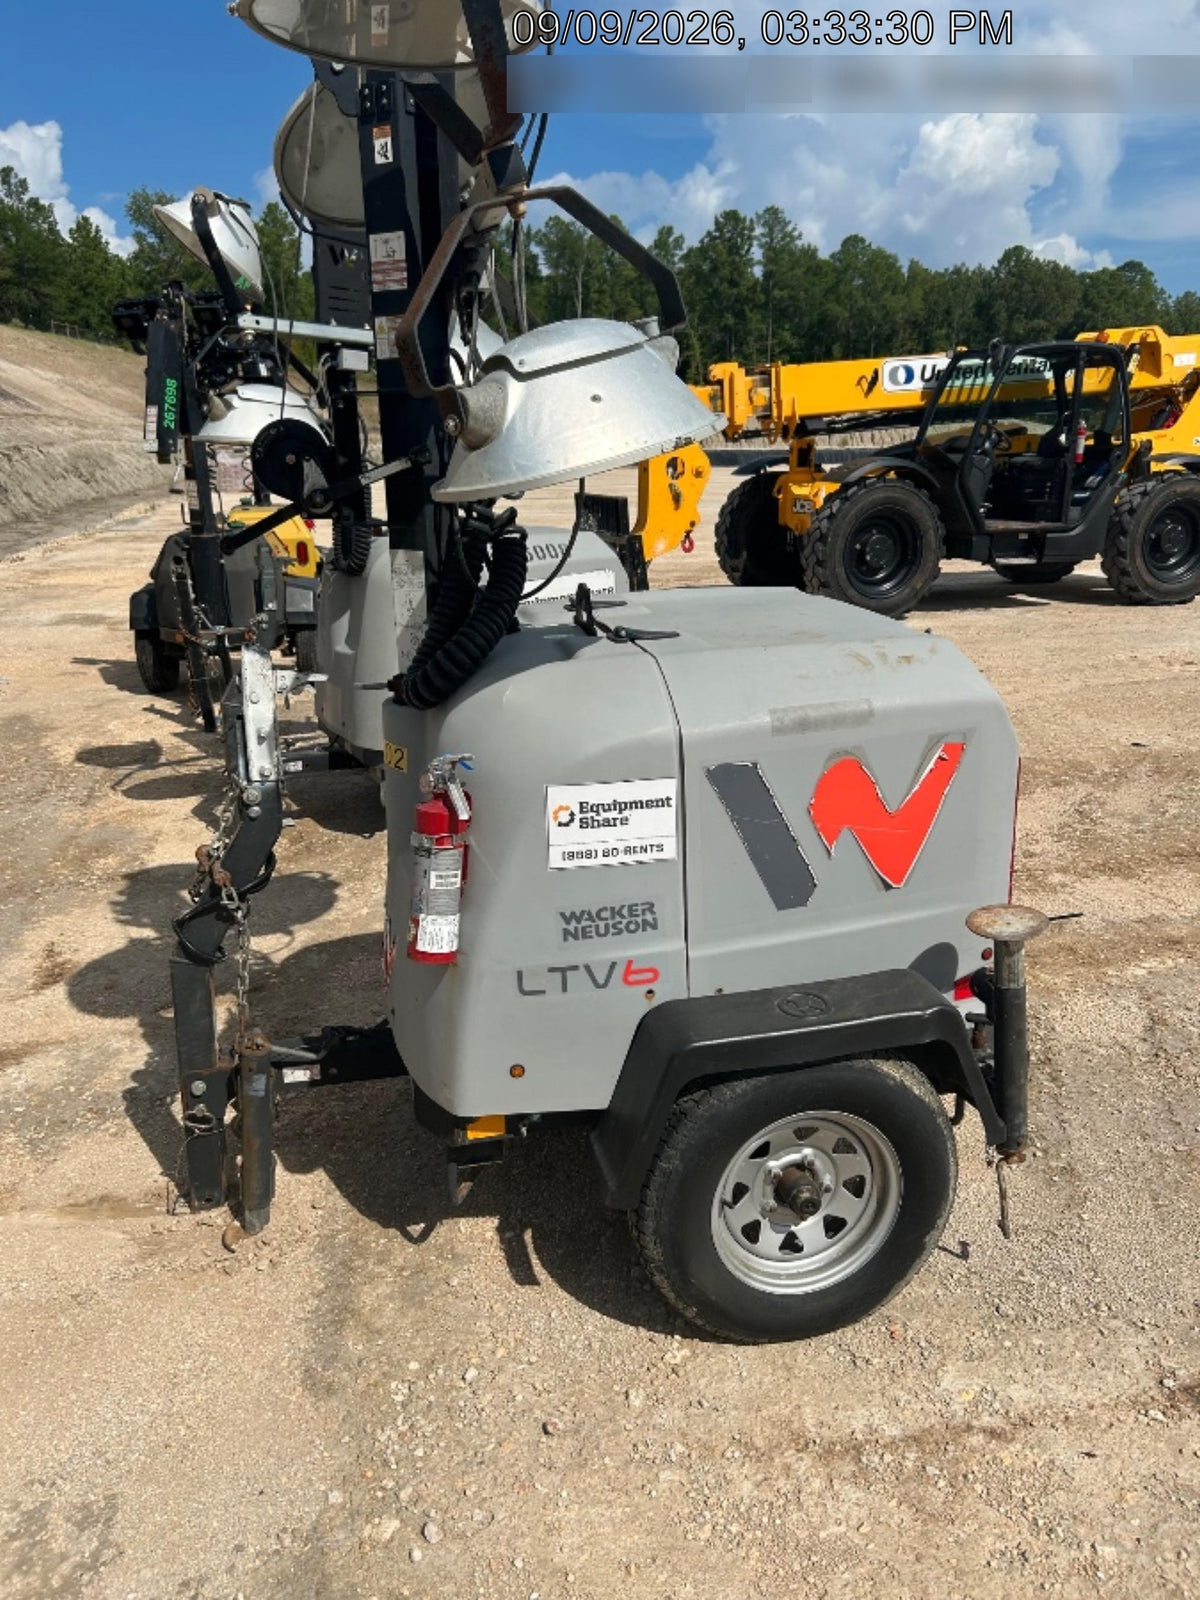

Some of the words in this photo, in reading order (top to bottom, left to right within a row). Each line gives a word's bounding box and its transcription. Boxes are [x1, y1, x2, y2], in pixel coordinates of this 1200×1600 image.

[578, 796, 673, 817] Equipment
[578, 815, 630, 830] Share
[558, 901, 657, 926] WACKER
[561, 917, 659, 943] NEUSON
[516, 959, 660, 996] LTV6
